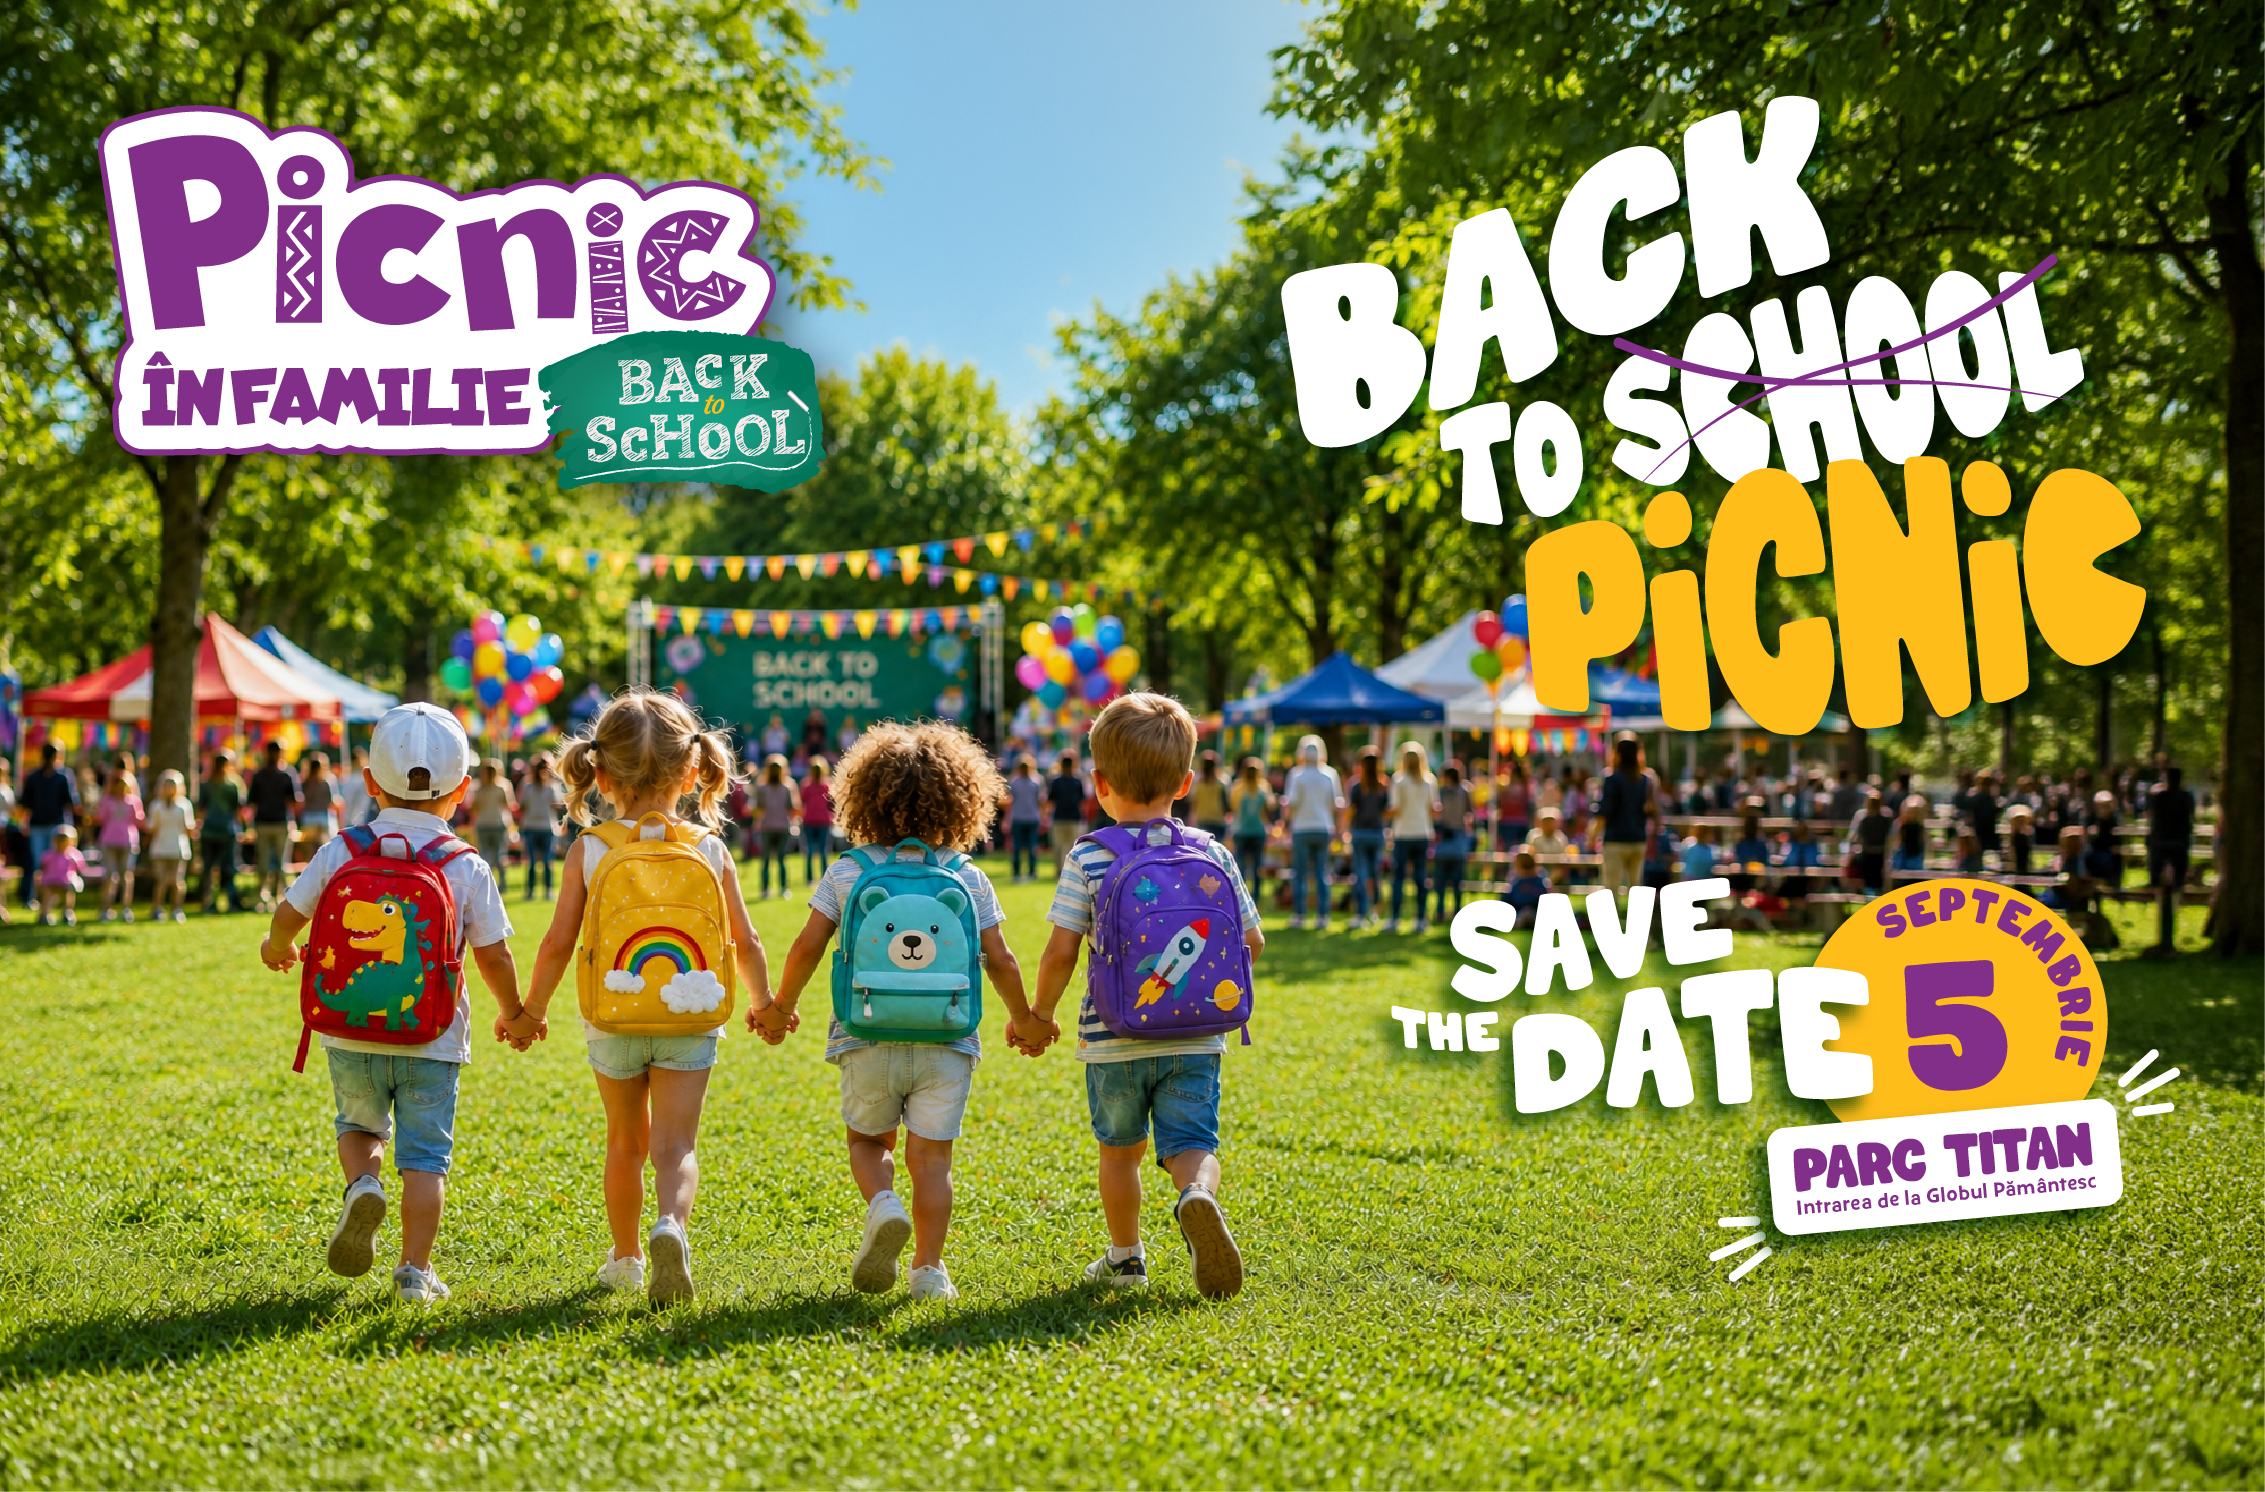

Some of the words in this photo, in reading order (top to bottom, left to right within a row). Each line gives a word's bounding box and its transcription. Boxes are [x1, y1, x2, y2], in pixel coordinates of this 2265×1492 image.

[752, 650, 830, 677] BACK
[837, 650, 879, 677] TO
[752, 681, 880, 708] SCHOOL
